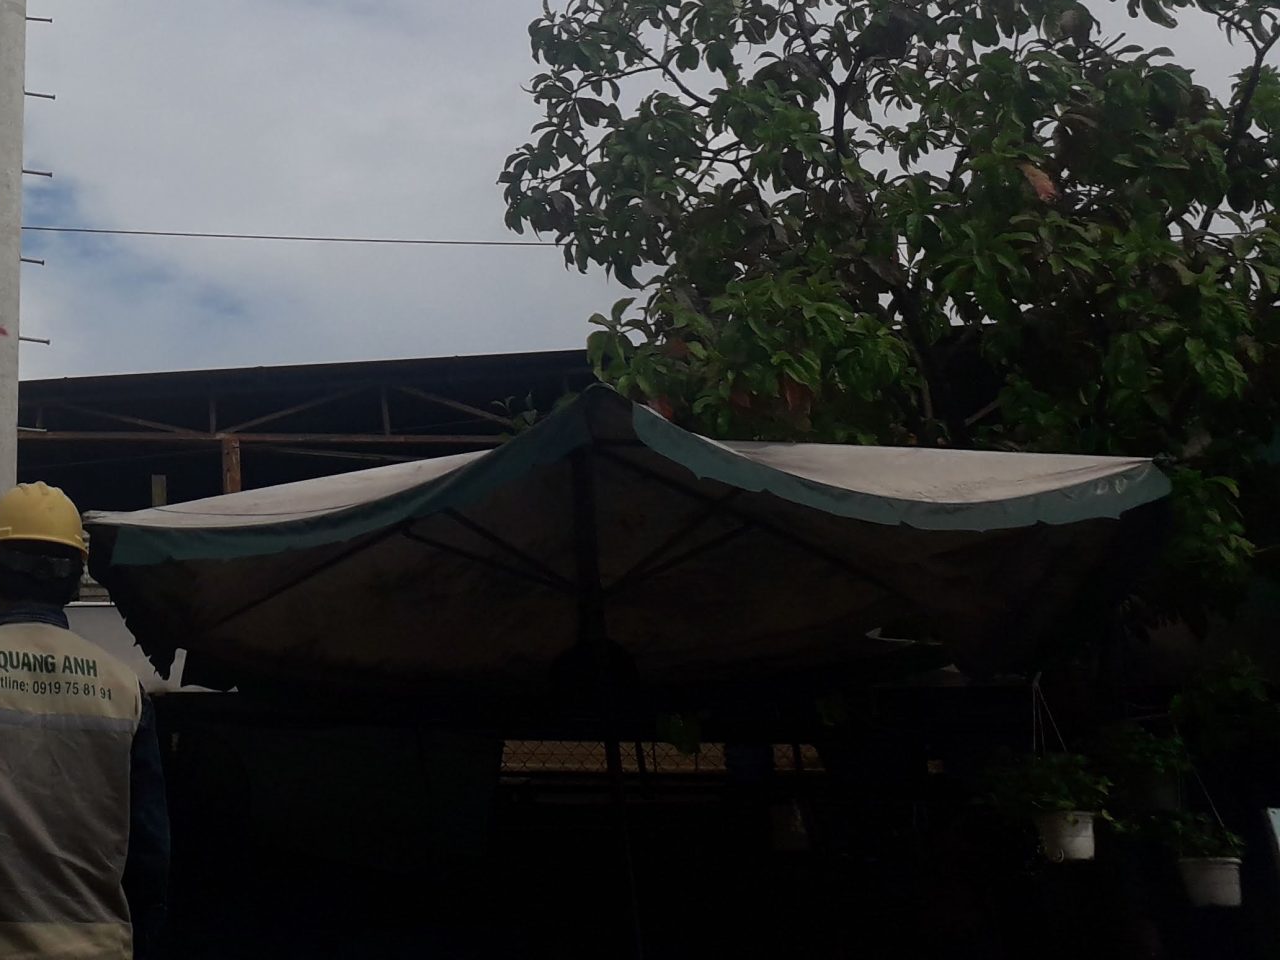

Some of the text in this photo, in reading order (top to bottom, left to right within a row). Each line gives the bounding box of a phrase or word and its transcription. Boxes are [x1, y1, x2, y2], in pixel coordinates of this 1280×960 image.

[62, 655, 98, 677] ANH
[32, 680, 61, 695] 0919
[66, 681, 79, 695] 75
[83, 683, 96, 697] 81
[100, 687, 112, 700] 91
